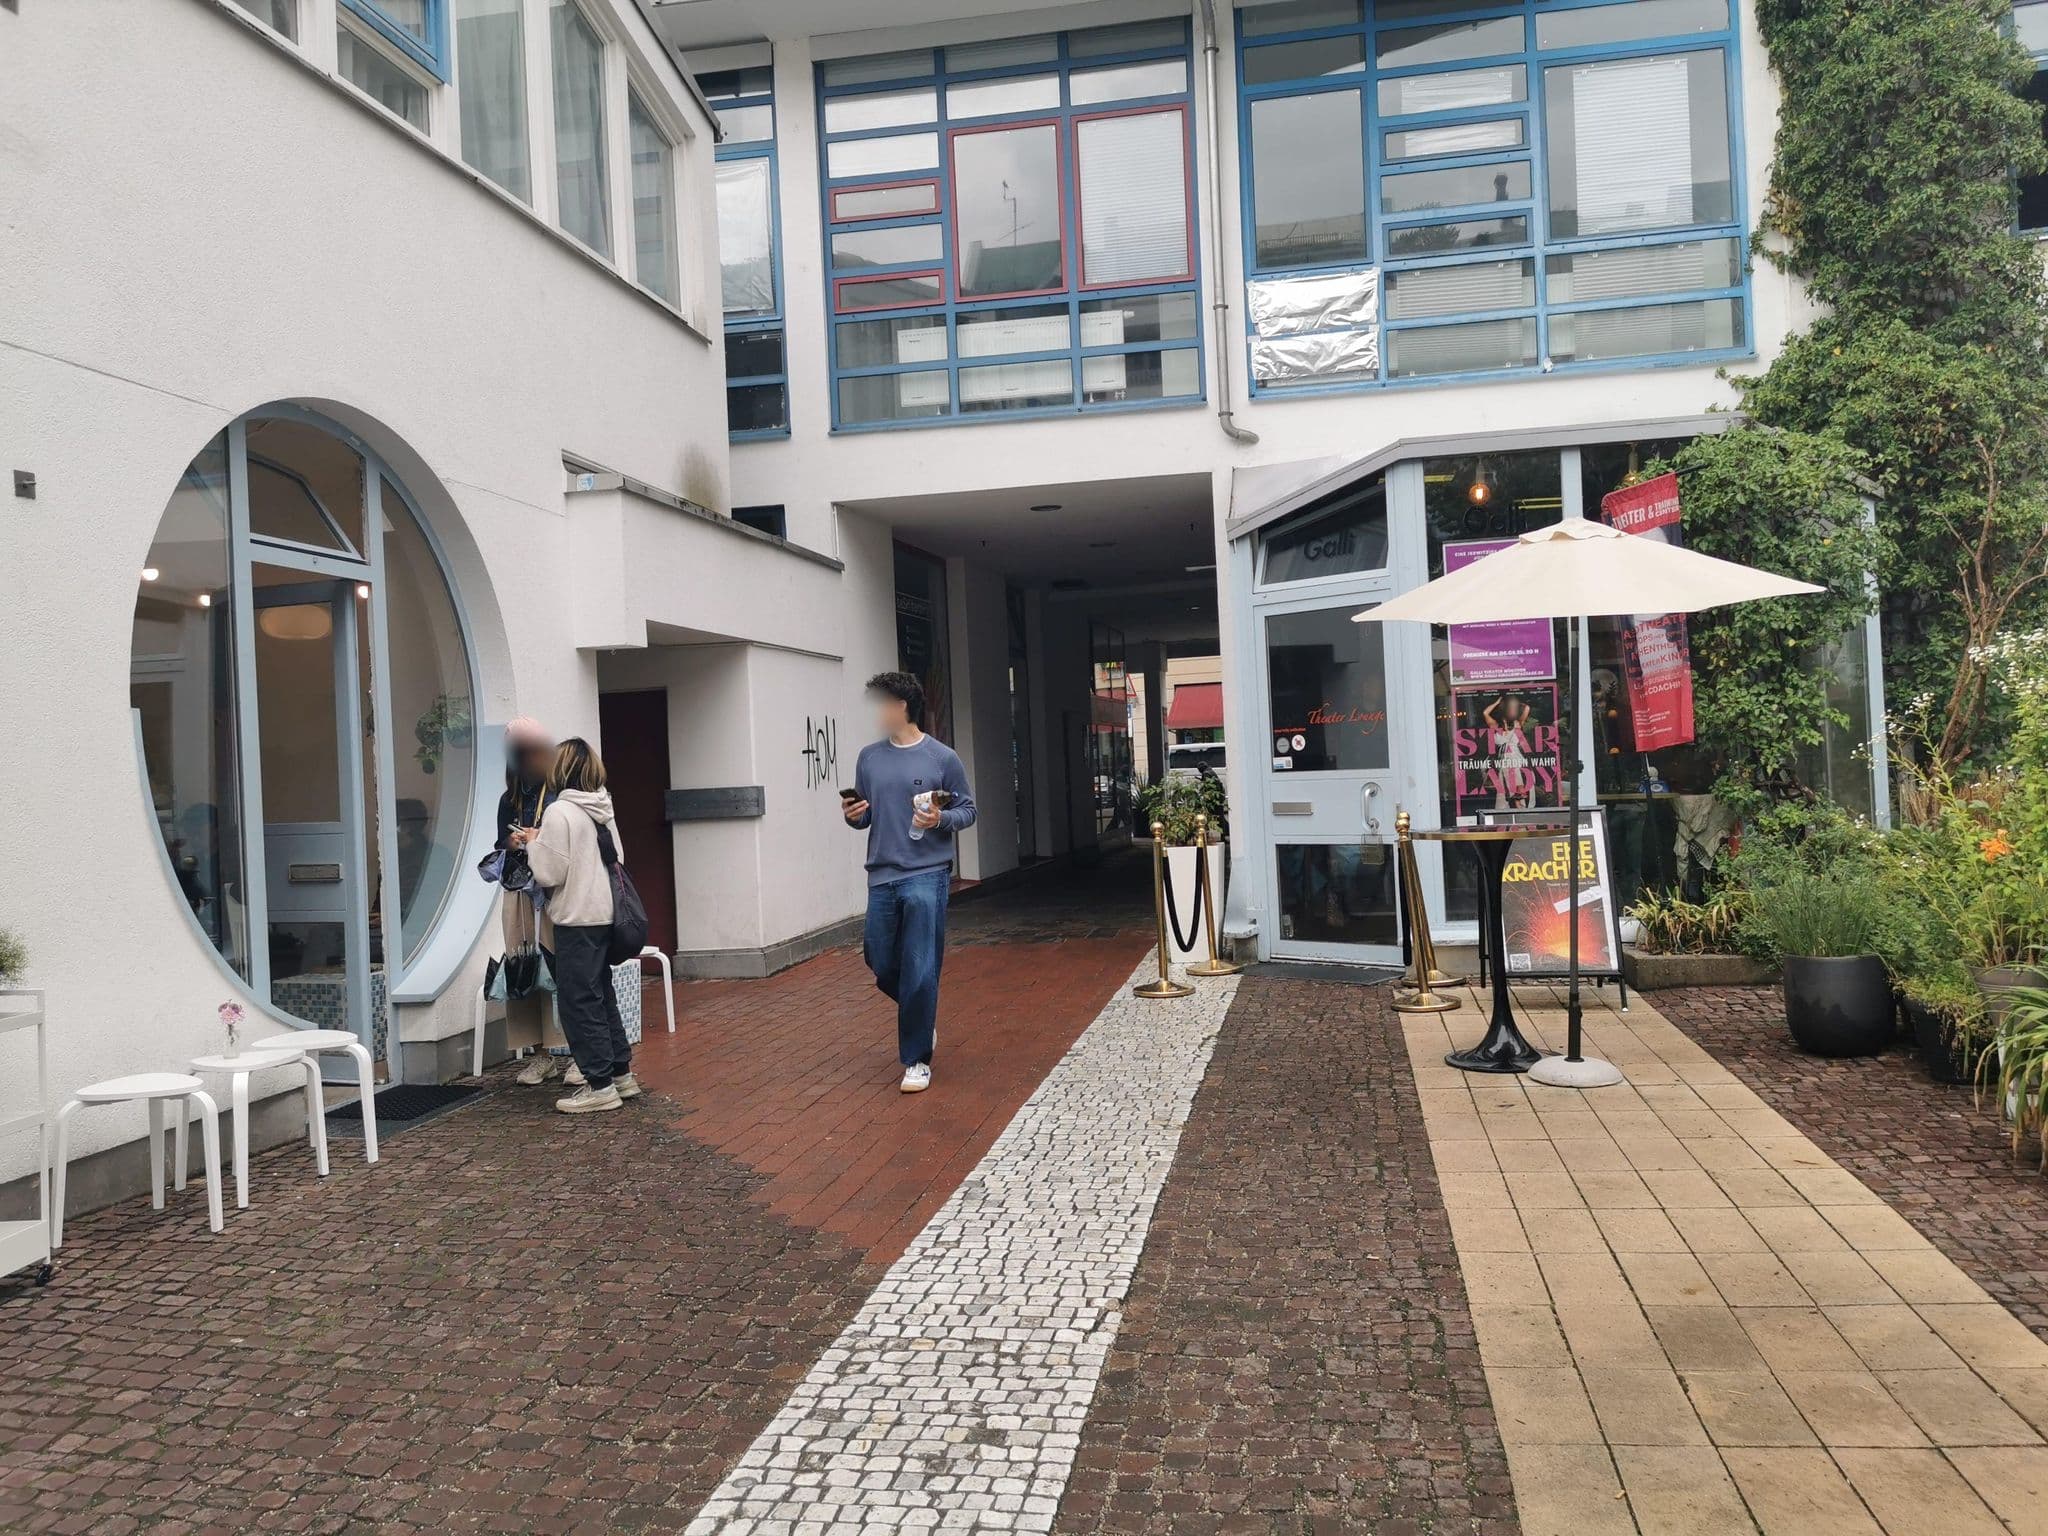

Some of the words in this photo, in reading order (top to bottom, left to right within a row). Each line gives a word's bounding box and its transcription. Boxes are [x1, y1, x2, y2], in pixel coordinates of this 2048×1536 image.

[1303, 529, 1356, 561] Galli
[1308, 702, 1346, 725] Theater
[1346, 705, 1385, 735] Lounge
[1455, 725, 1560, 757] STAR
[1459, 758, 1492, 770] TRÄUME
[1494, 758, 1529, 769] WERDEN
[1531, 757, 1556, 768] WAHR
[1457, 767, 1560, 796] LADY
[1502, 860, 1596, 882] KRACHR
